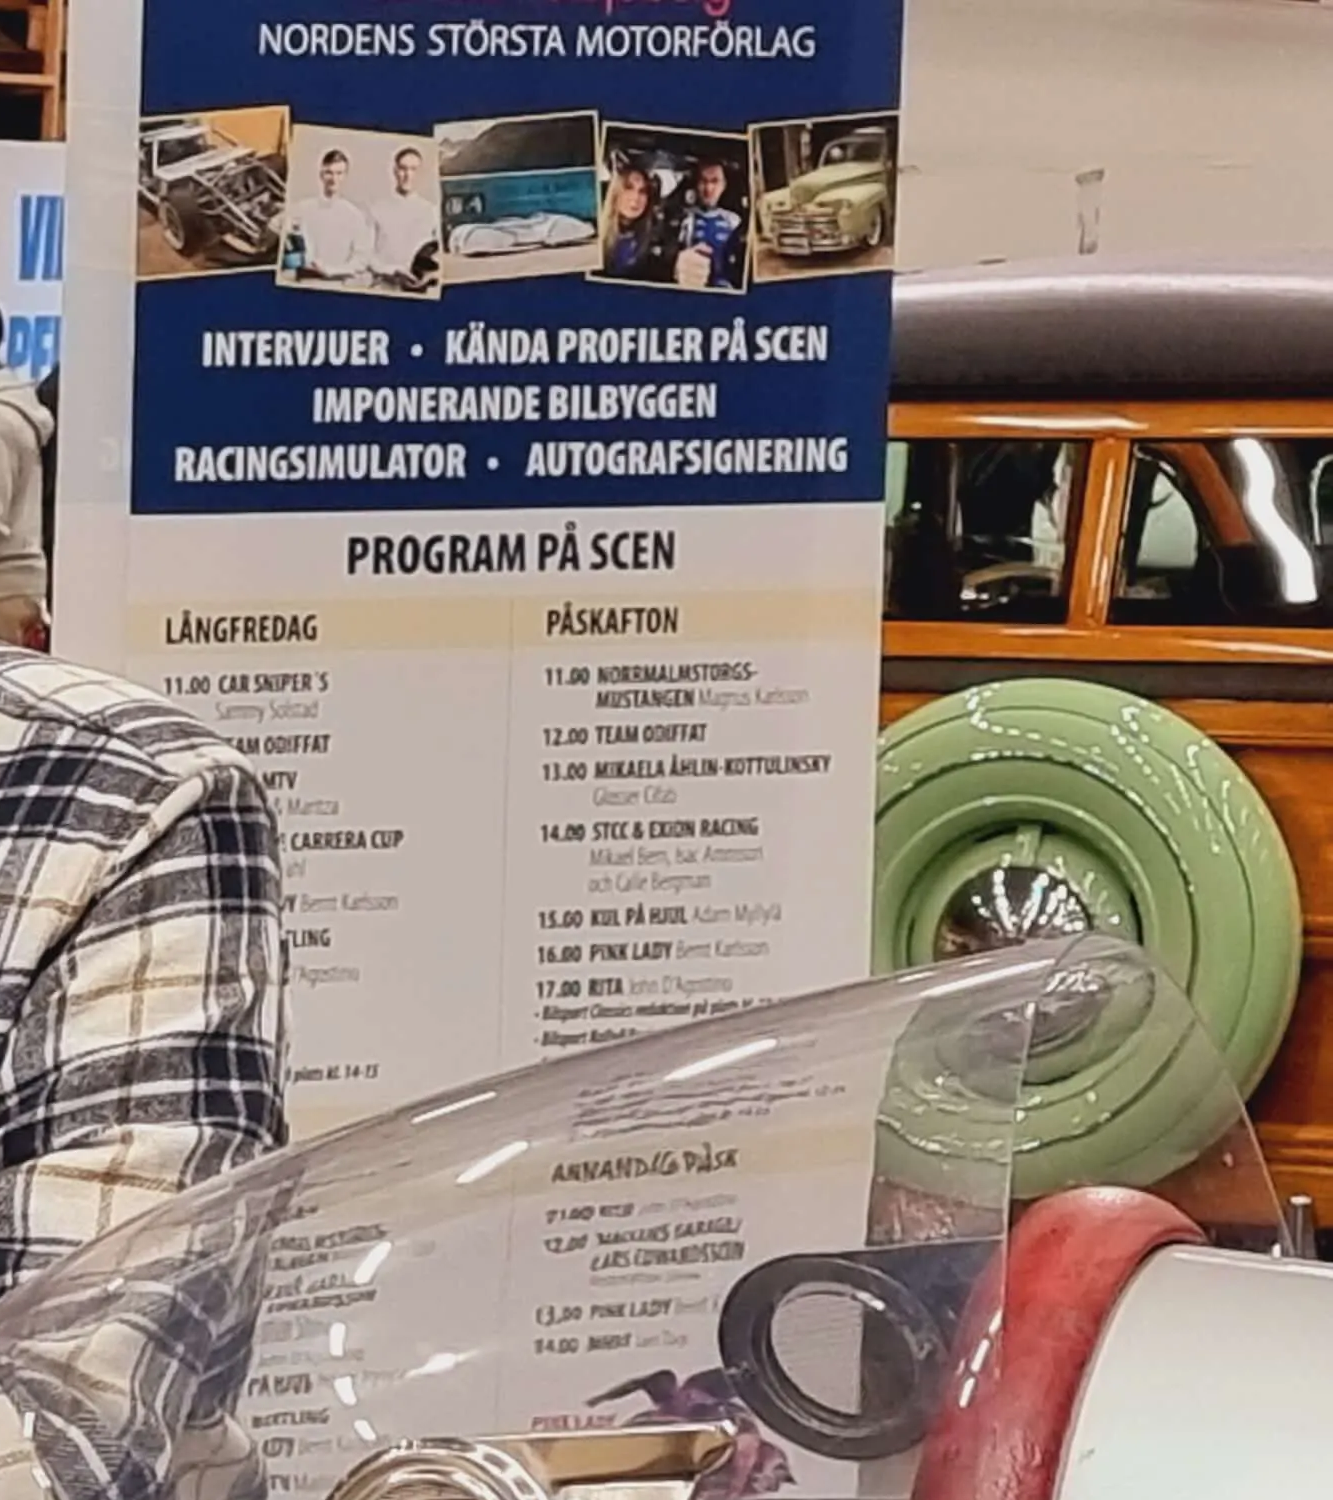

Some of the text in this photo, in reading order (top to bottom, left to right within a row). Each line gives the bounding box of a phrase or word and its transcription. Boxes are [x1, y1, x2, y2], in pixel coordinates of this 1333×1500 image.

[258, 19, 817, 57] NORDENS STÖRSTA MOTORFÖRLAG
[202, 317, 828, 367] INTERVJUER KÄNDA PROFILER PÅ SCEN
[313, 383, 717, 423] IMPONERANDE BILBYGGEN
[175, 437, 848, 481] RACINGSIMULATOR AUTOGRAFSIGNERING
[347, 521, 676, 575] PROGRAM PÅ SCEN
[165, 609, 318, 645] LÅNGFREDAG
[546, 601, 679, 636] PÅSKAFTON
[163, 675, 210, 695] 11.00
[218, 674, 250, 694] CAR
[544, 666, 591, 686] 11.00
[595, 688, 695, 709] MUSTANGEN
[543, 727, 589, 746] 12.00
[595, 725, 639, 744] TEAM
[542, 762, 587, 781] 13.00
[594, 759, 666, 779] MIKAELA
[290, 830, 367, 851] CARRERA
[370, 829, 405, 849] CUP
[541, 823, 586, 843] 14.00
[592, 821, 630, 841] STCC
[632, 820, 644, 840] &
[700, 816, 759, 838] RACING
[538, 909, 584, 930] 15.00
[590, 908, 621, 927] KUL
[625, 902, 646, 926] PÅ
[537, 944, 582, 964] 16.00
[589, 943, 629, 963] PINK
[632, 941, 673, 961] LADY
[536, 979, 581, 999] 17.00
[587, 977, 623, 996] RITA
